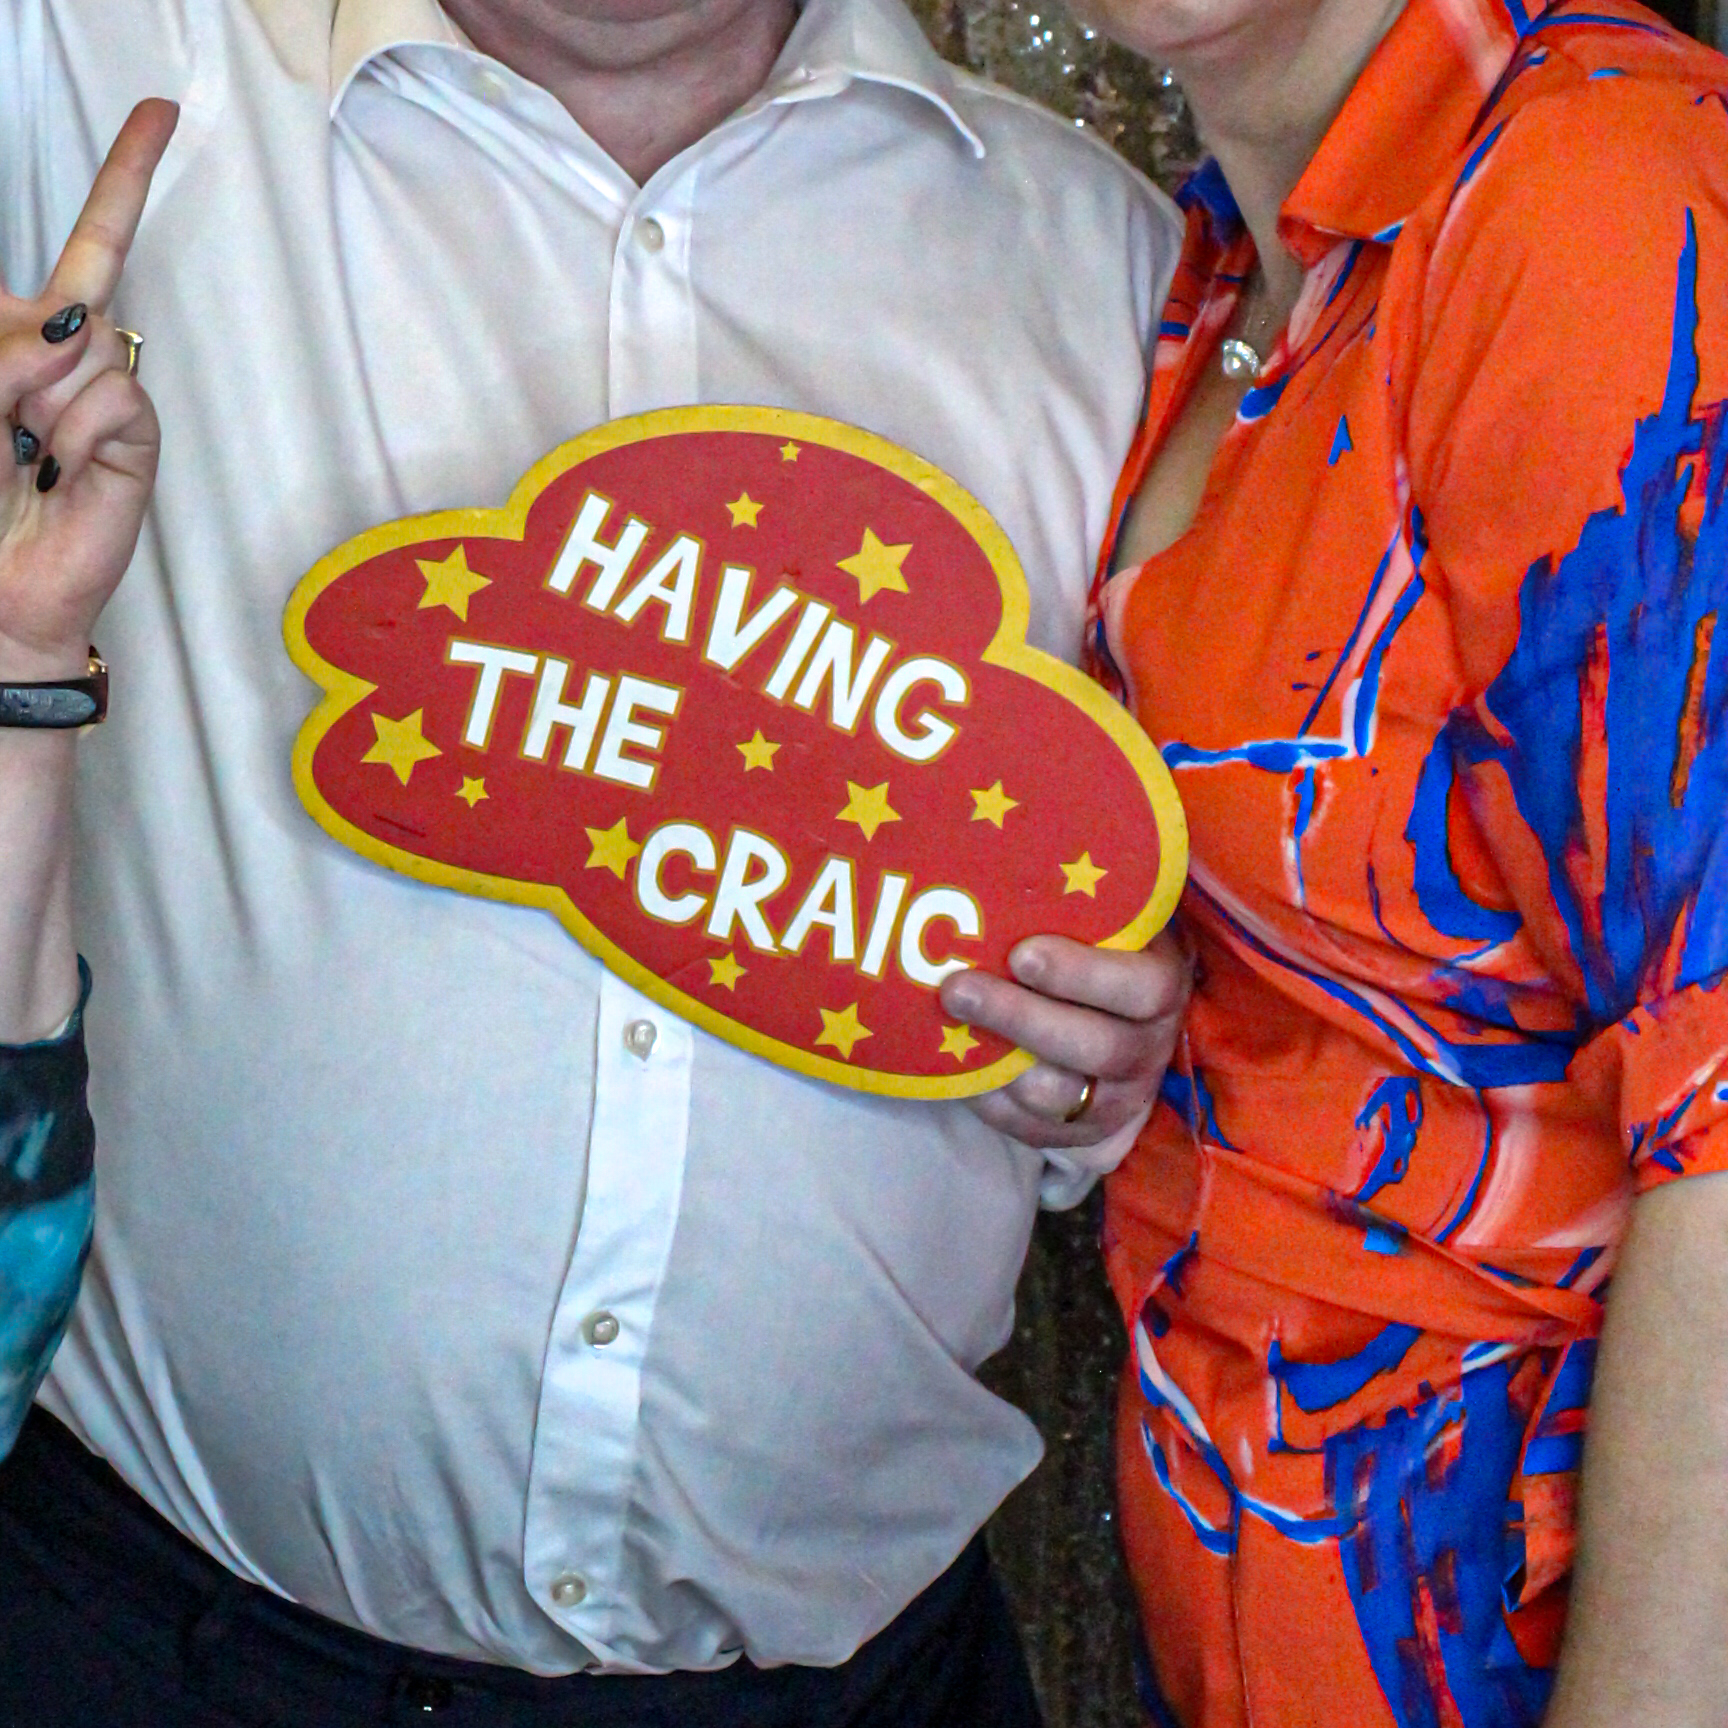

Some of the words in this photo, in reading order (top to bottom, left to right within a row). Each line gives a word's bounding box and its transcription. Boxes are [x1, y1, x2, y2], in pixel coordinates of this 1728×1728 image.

[546, 491, 969, 763] HAVING
[448, 640, 680, 790] THE
[634, 822, 981, 989] CRAIC
